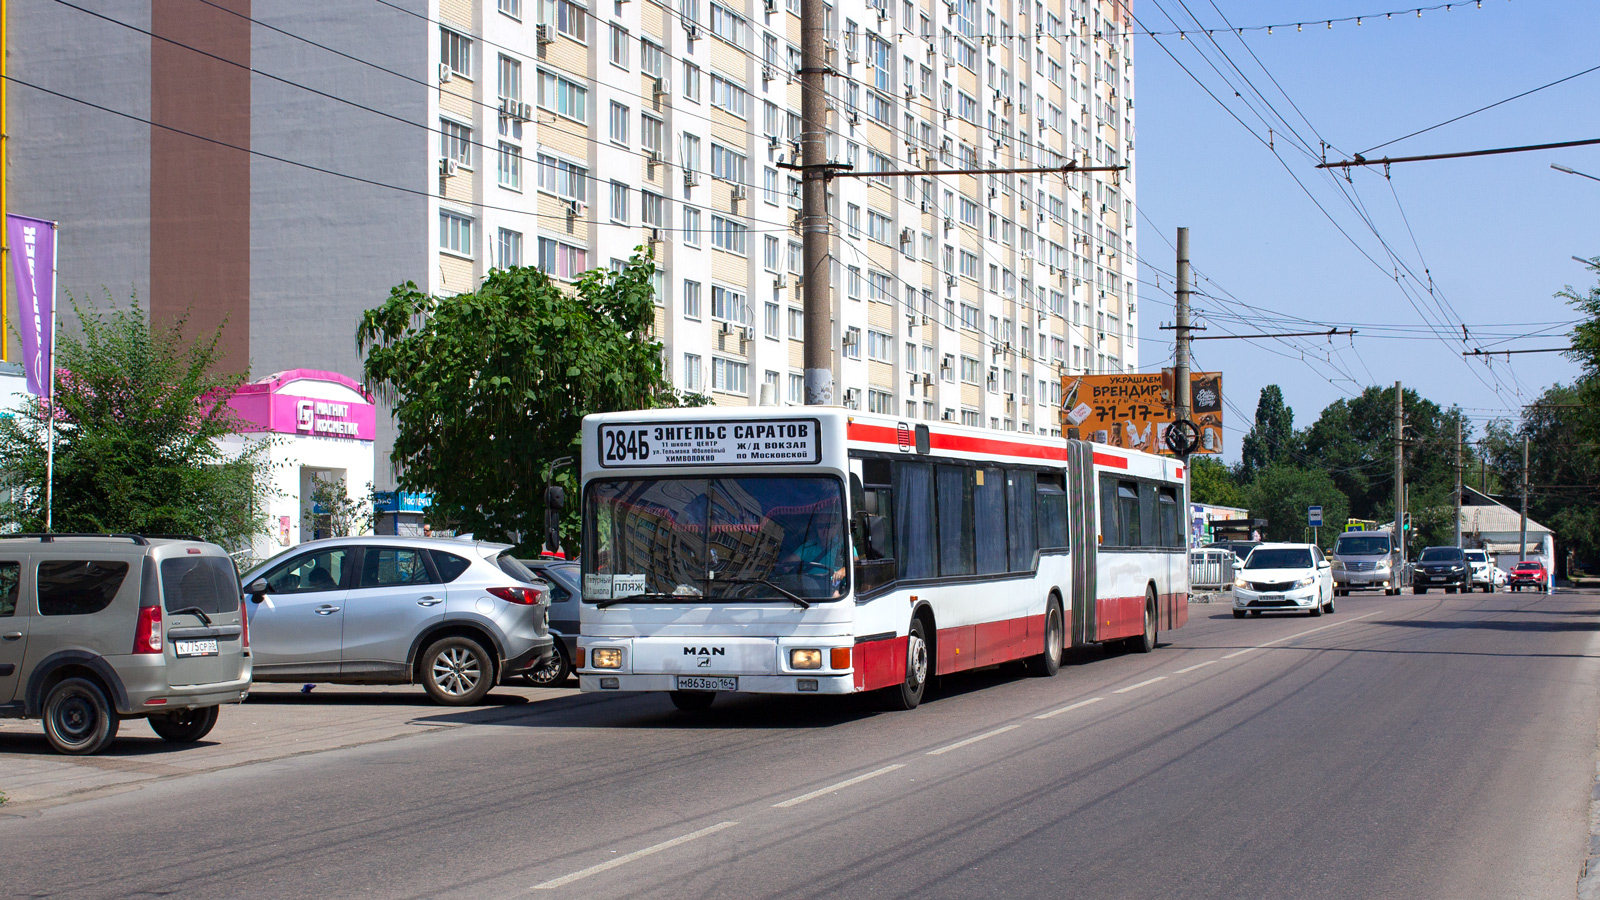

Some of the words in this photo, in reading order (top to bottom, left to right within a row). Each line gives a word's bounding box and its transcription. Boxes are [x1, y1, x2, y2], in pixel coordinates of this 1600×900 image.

[1109, 376, 1162, 384] УКРАШАЕМ
[315, 402, 348, 417] МАГНИТ
[314, 419, 360, 436] КОСМЕТИК
[654, 426, 727, 441] ЭНГЕЛЬС
[734, 424, 809, 439] САРАТОВ
[605, 429, 651, 462] 284Б
[736, 442, 760, 450] Ж/Д
[764, 441, 807, 450] ВОКЗАЛ
[750, 450, 808, 459] Московской
[614, 582, 644, 591] ПЛЯЖ
[683, 646, 725, 656] MAN
